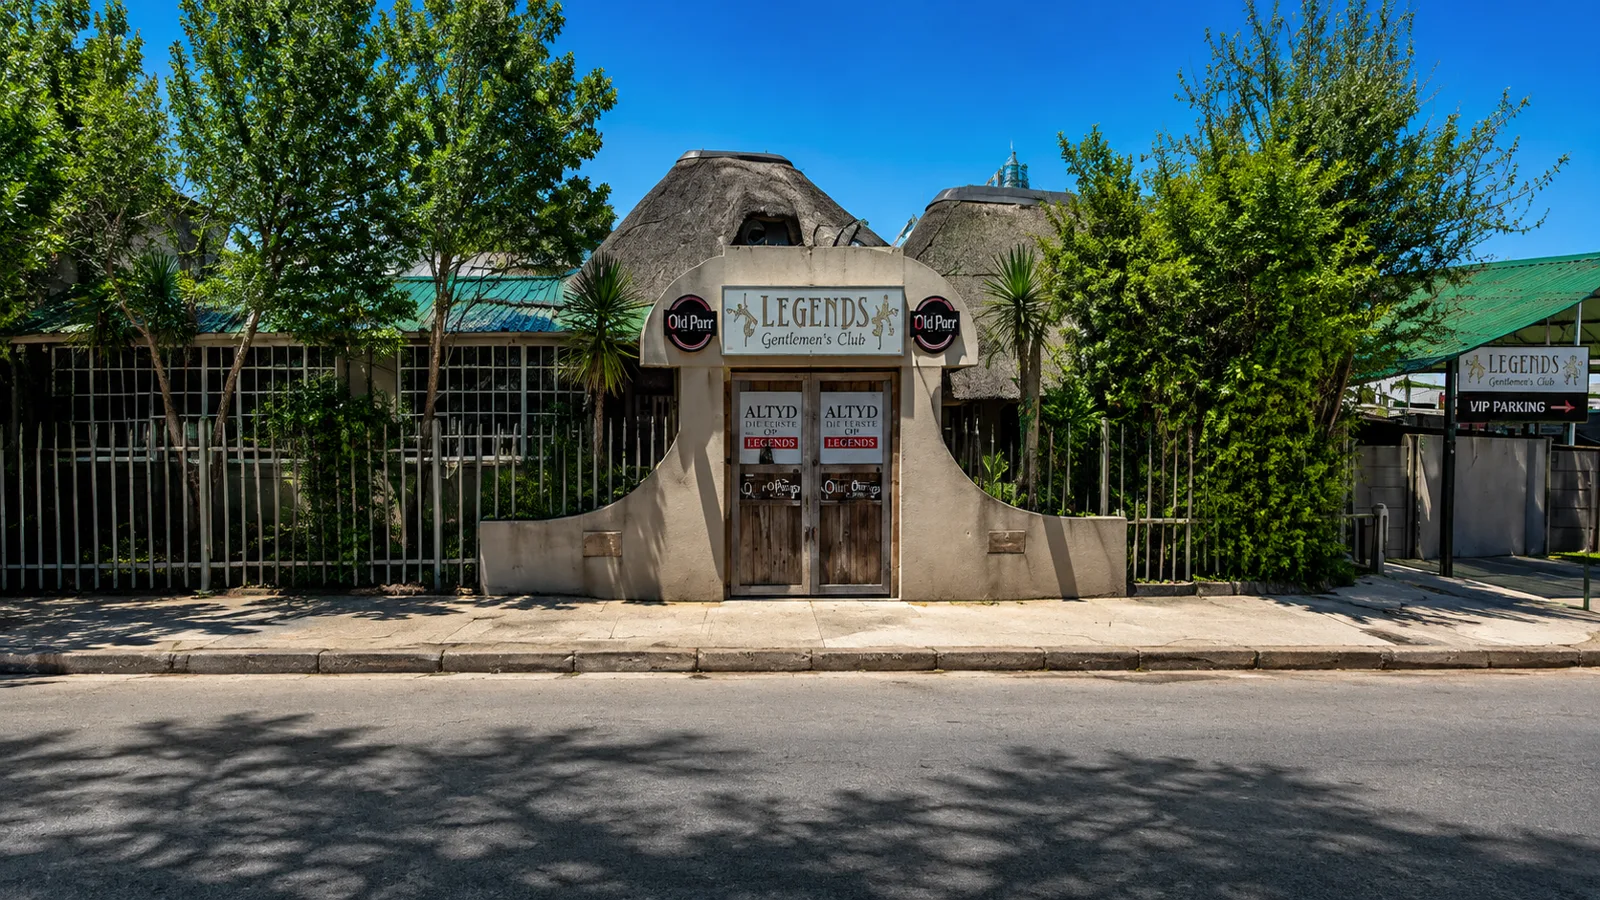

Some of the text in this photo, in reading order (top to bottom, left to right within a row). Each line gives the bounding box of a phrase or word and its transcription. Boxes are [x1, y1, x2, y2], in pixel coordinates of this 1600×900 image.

[761, 295, 869, 329] LEGENDS
[668, 313, 714, 330] Old Parr
[914, 314, 957, 330] Old Parr
[761, 331, 866, 349] Gentlemen's Club
[1488, 354, 1559, 374] LEGENDS
[1536, 376, 1555, 386] Club
[744, 405, 798, 419] ALTYD
[824, 405, 878, 419] ALTYD
[1470, 400, 1545, 413] VIP PARKING
[747, 438, 795, 448] LEGENDS
[827, 438, 875, 448] LEGENDS
